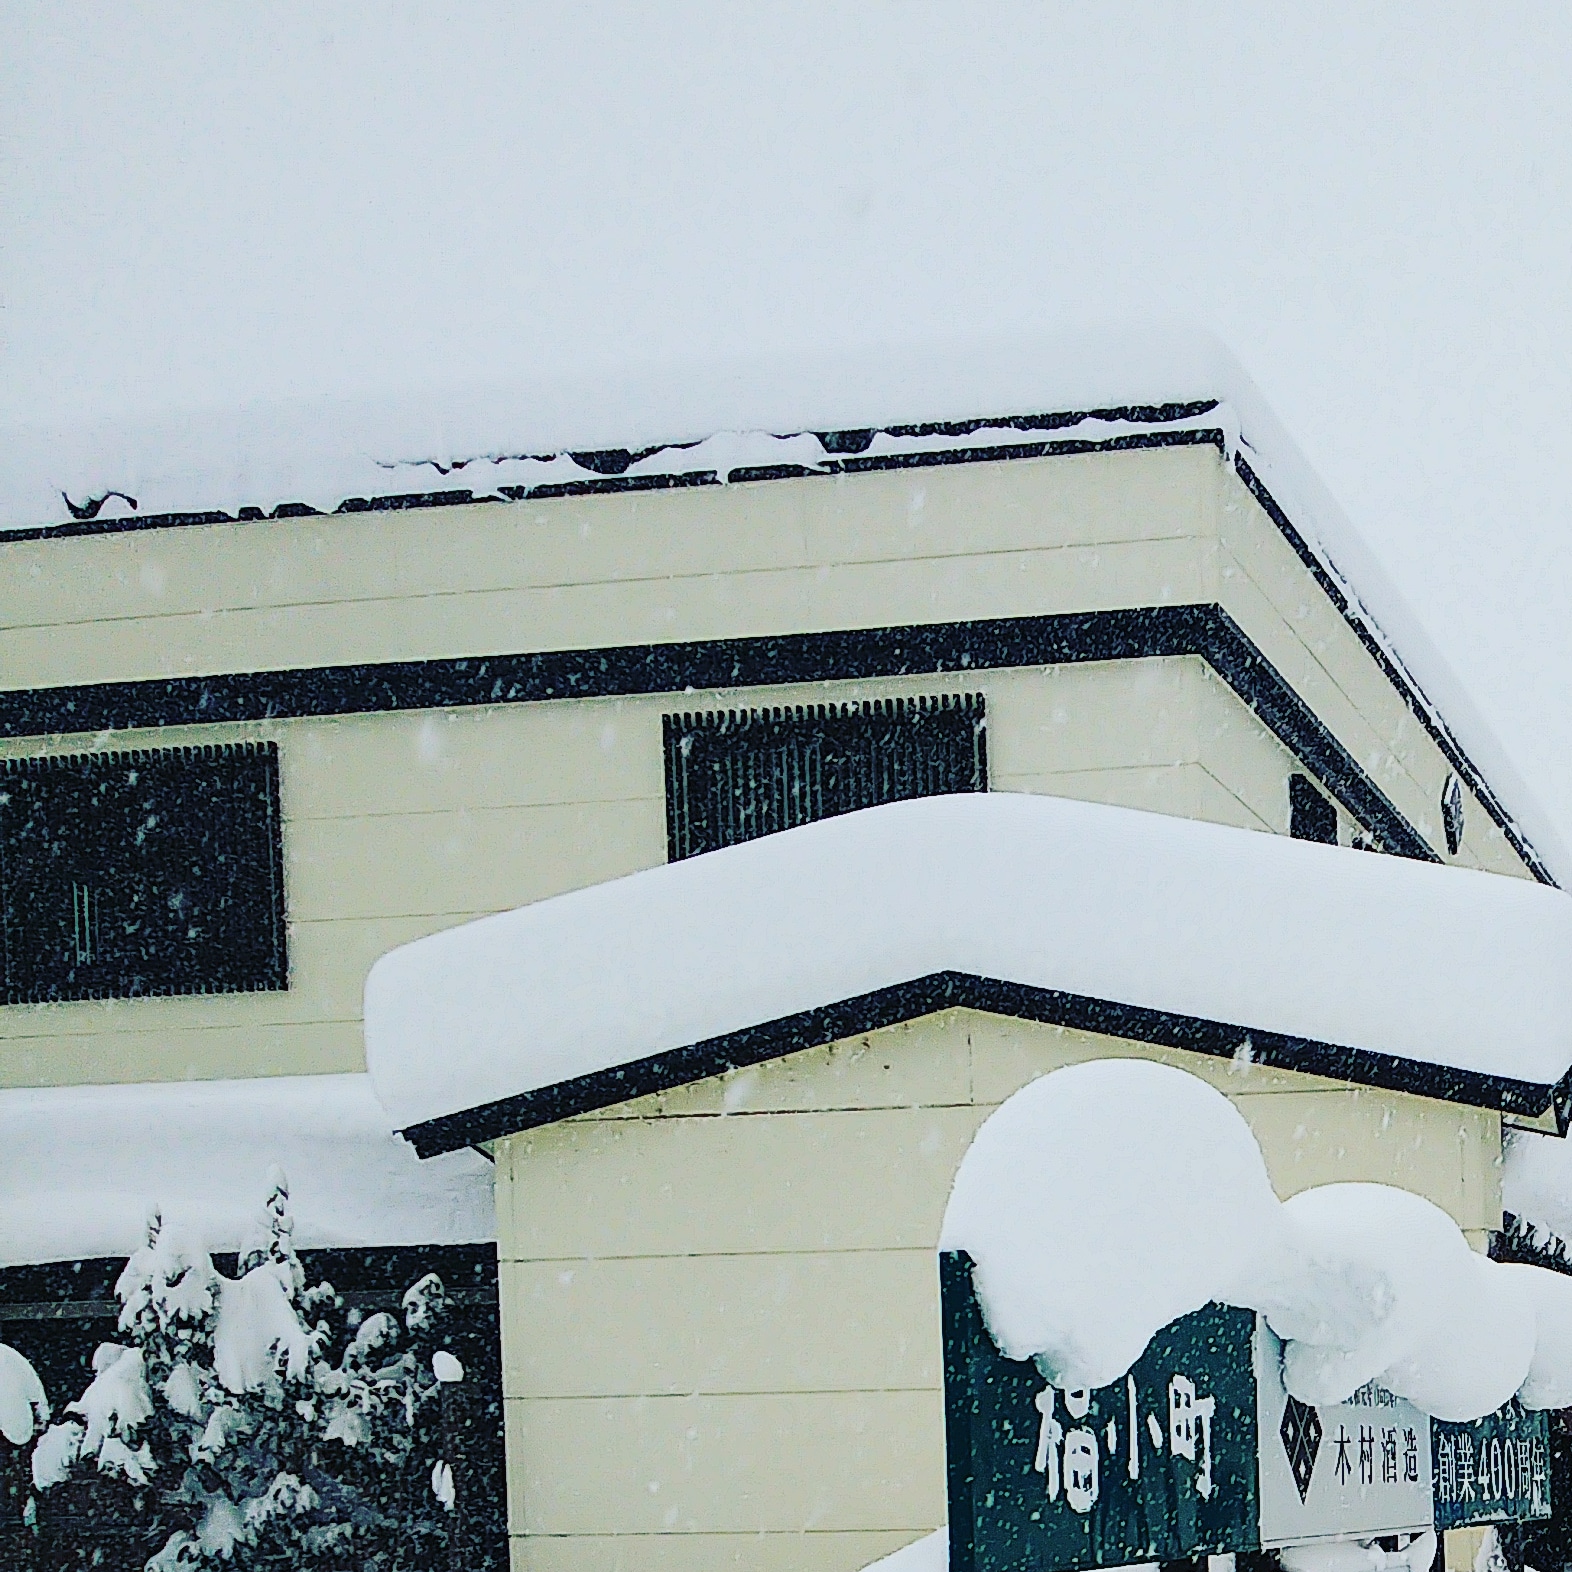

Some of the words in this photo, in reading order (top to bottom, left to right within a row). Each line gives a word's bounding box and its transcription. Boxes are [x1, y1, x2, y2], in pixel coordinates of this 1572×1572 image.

[1035, 1373, 1216, 1513] 福小町
[1333, 1425, 1419, 1486] 木村酒造
[1438, 1432, 1546, 1517] 創業400周年
